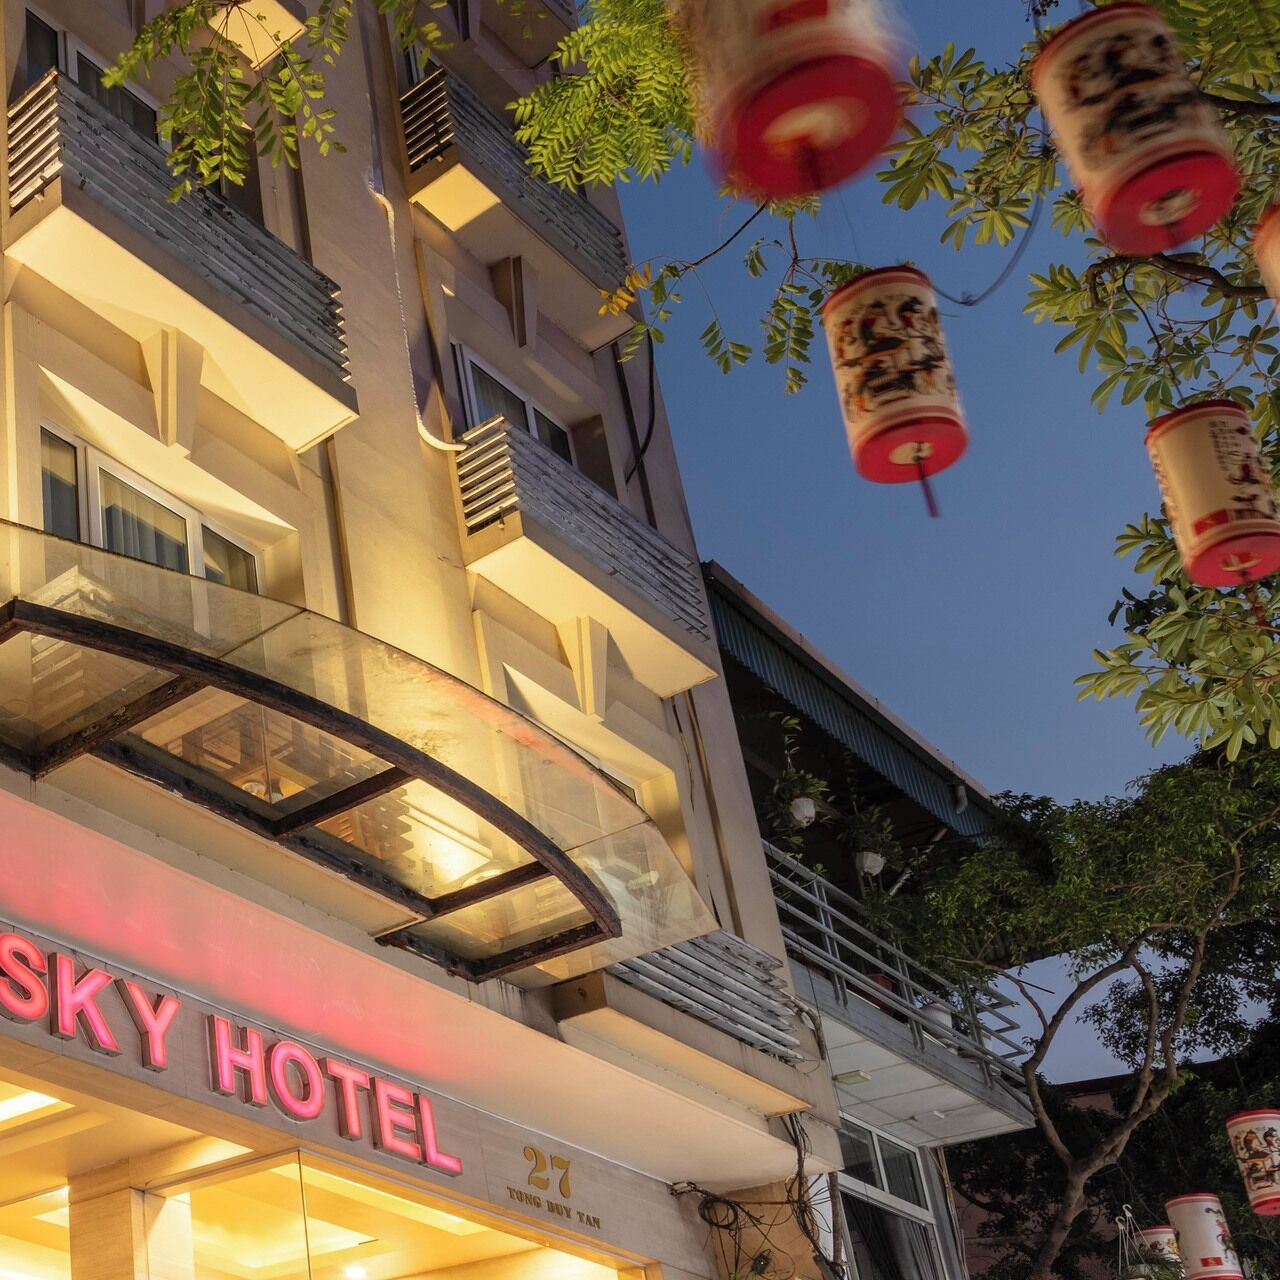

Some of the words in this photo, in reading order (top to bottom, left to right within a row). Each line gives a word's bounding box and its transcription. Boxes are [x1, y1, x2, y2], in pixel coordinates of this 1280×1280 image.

[206, 1014, 464, 1177] HOTEL
[523, 1145, 572, 1200] 27
[506, 1185, 542, 1209] TONG
[576, 1210, 601, 1230] TAN
